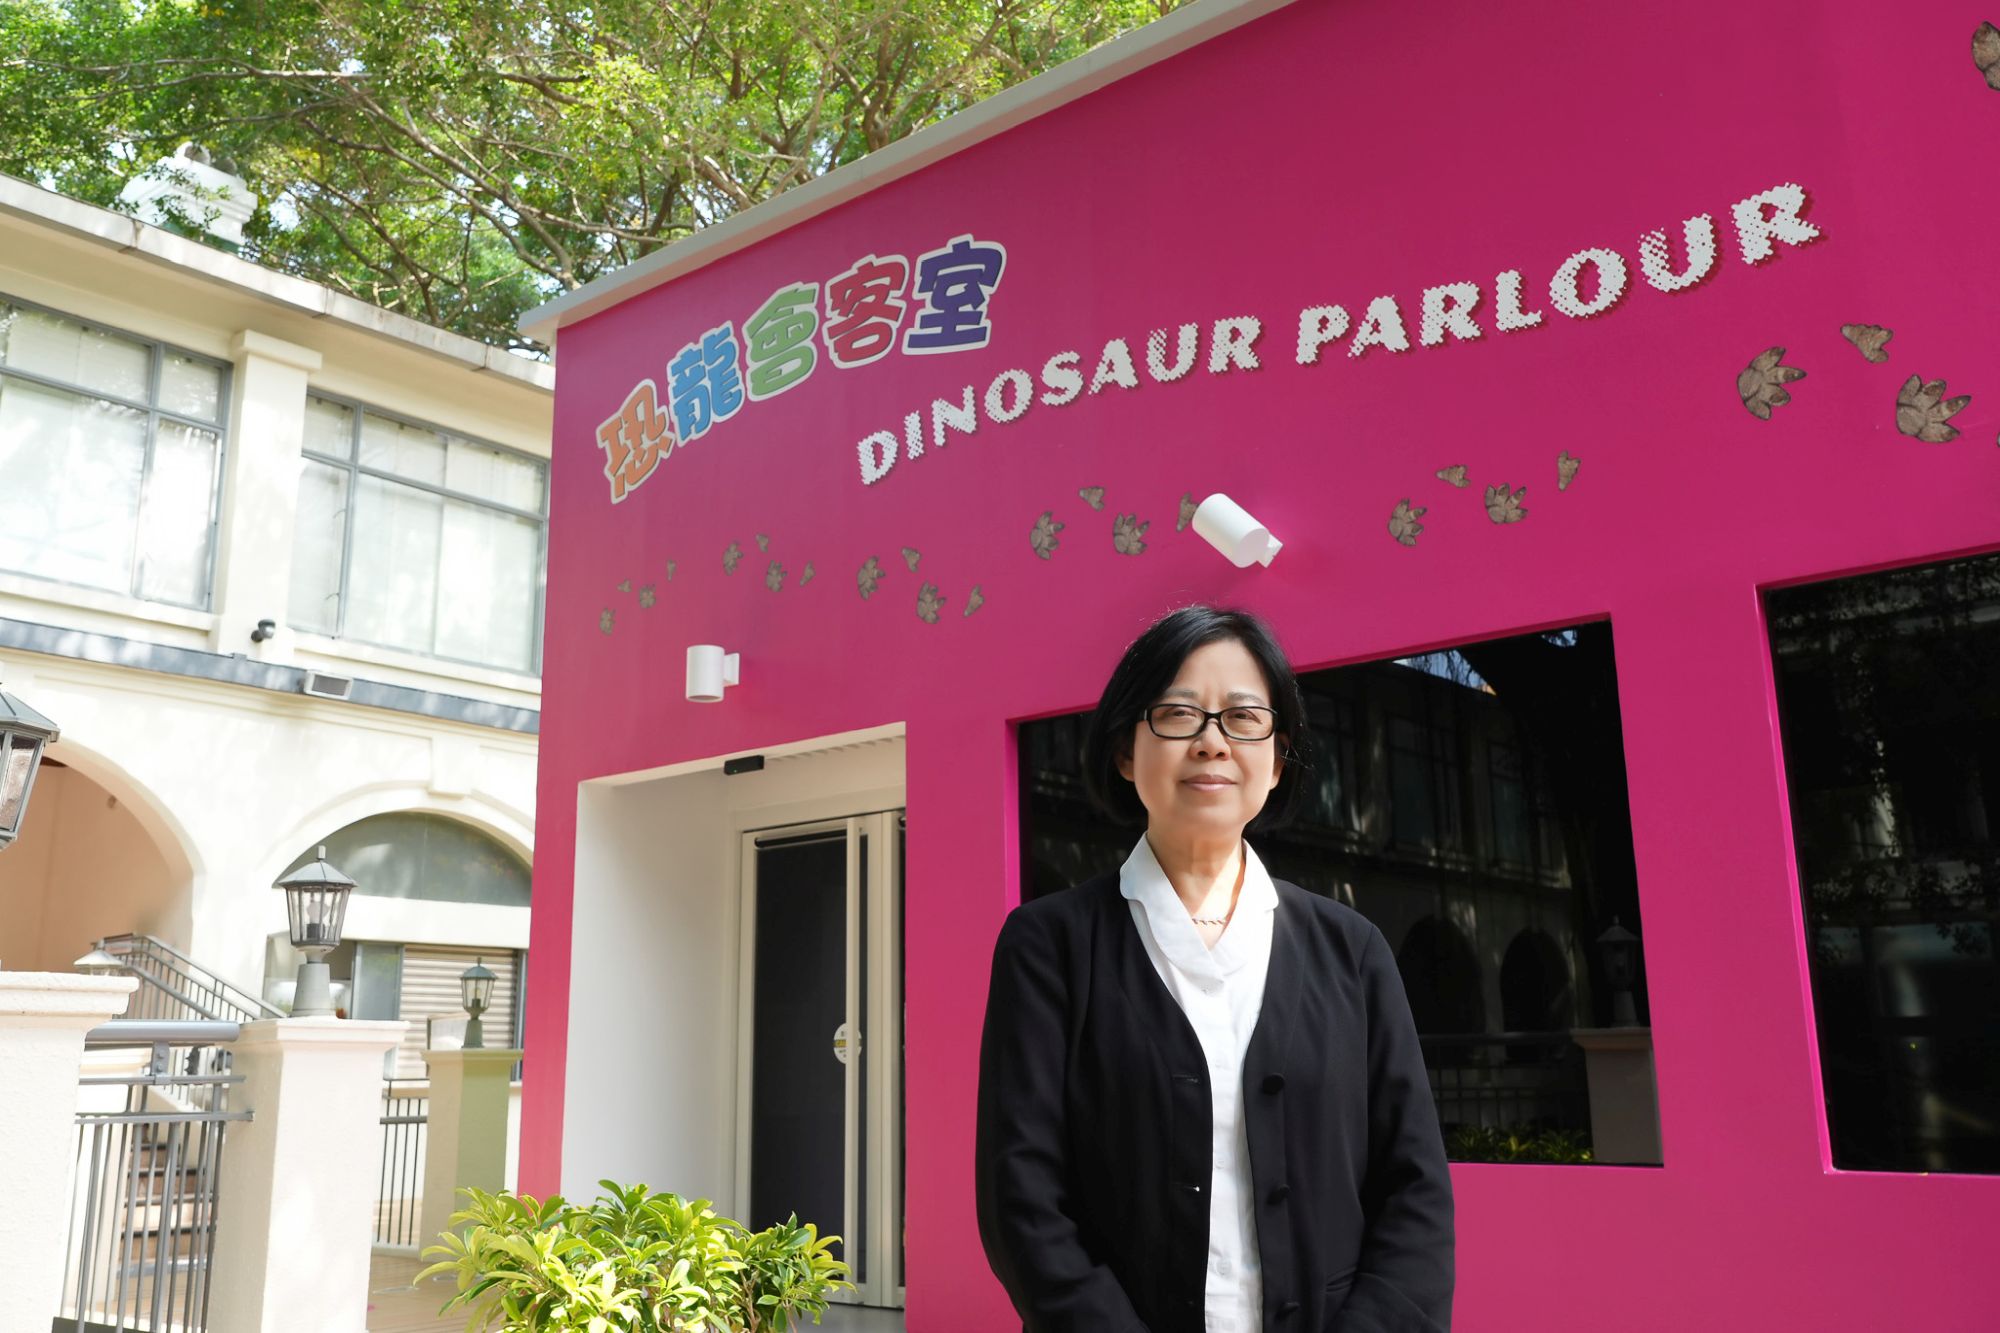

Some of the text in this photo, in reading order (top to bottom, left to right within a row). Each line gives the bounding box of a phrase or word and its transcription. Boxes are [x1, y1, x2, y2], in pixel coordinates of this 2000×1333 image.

[597, 235, 1006, 502] 恐龍會客室
[857, 183, 1820, 485] DINOSAUR PARLOUR
